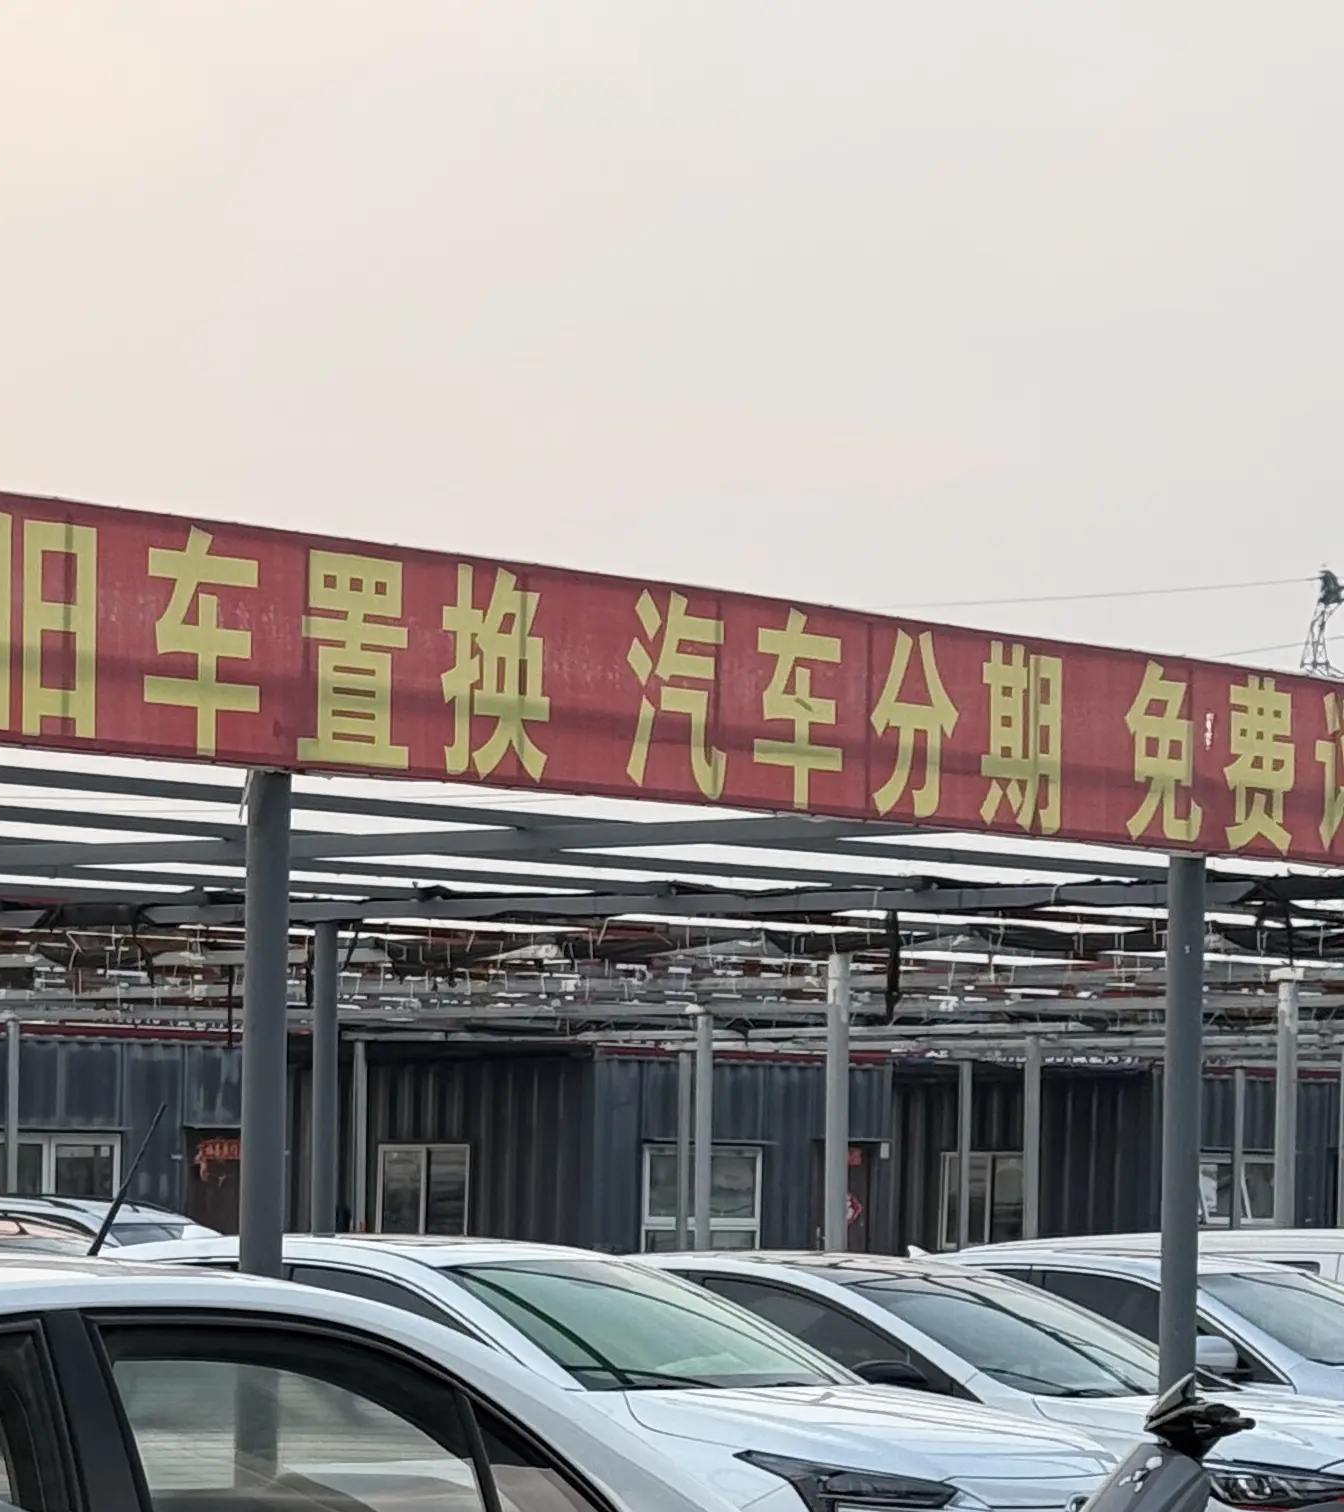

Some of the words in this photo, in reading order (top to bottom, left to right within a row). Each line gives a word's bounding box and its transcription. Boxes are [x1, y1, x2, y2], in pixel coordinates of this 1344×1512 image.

[627, 588, 1063, 835] 汽车分期
[1124, 659, 1344, 856] 免费
